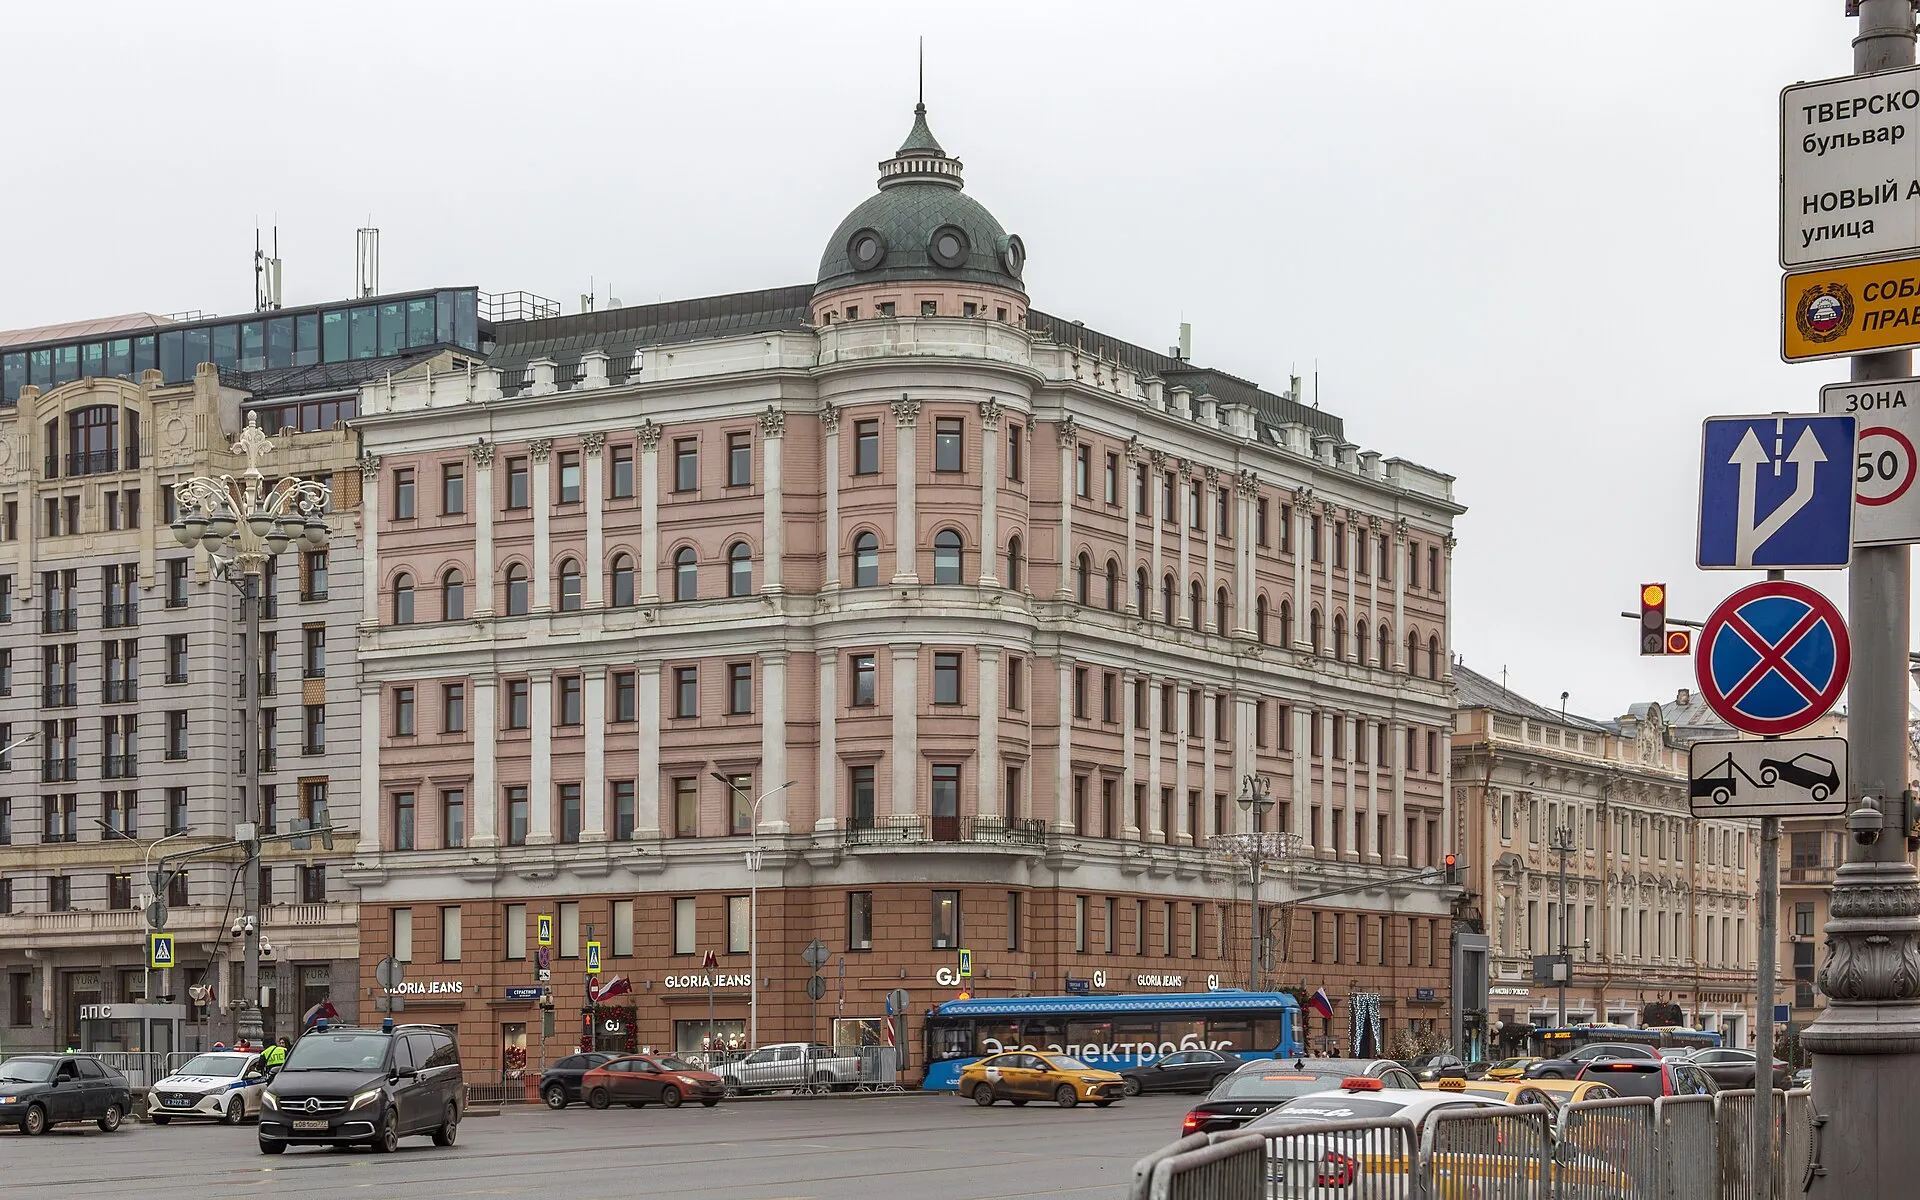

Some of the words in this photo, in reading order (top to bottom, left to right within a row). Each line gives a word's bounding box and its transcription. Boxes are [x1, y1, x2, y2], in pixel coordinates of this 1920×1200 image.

[1802, 89, 1920, 125] ТВЕРСКО
[1802, 124, 1905, 156] бульвар
[1802, 178, 1898, 215] НОВЫЙ
[1801, 219, 1875, 248] улица
[1845, 390, 1907, 412] ЗОНА
[1856, 450, 1898, 483] 50
[75, 975, 99, 985] YURA
[131, 975, 145, 984] YU
[258, 970, 277, 980] URA
[304, 969, 330, 979] YURA
[664, 975, 710, 988] GLORIA
[713, 974, 751, 987] JEANS
[936, 967, 961, 986] GJ
[1093, 970, 1106, 988] GJ
[1137, 974, 1161, 986] GLORIA
[1162, 975, 1182, 987] JEANS
[1207, 974, 1219, 990] GJ
[427, 981, 463, 993] JEANS
[80, 1005, 112, 1019] ДПС
